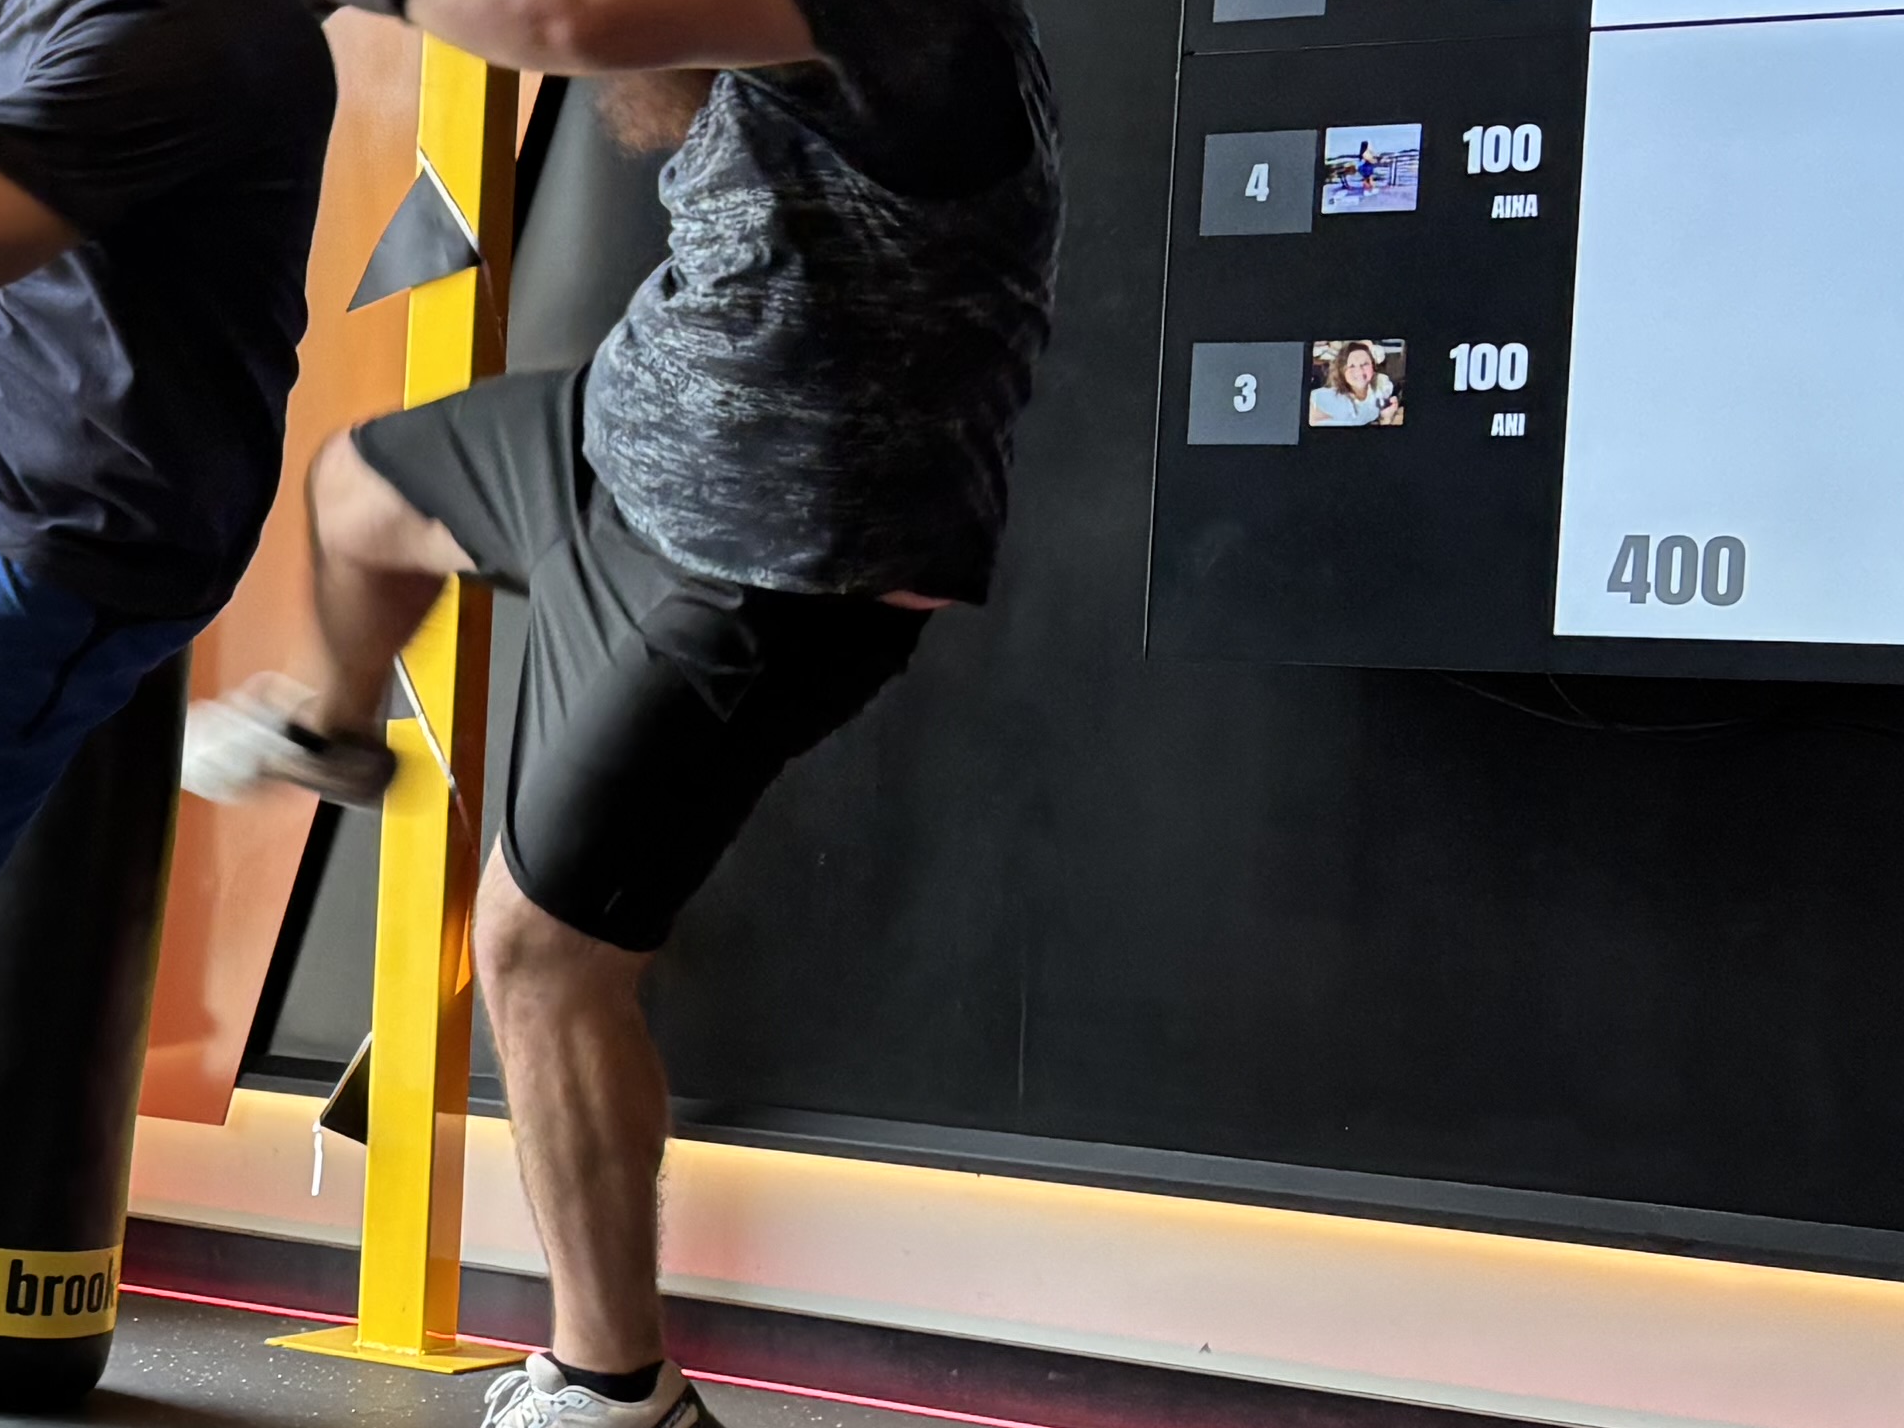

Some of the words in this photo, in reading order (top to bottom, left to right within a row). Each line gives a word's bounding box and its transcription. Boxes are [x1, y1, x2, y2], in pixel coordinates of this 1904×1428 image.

[1462, 123, 1542, 175] 100
[1245, 163, 1270, 202] 4
[1449, 342, 1529, 392] 100
[1233, 373, 1257, 412] 3
[1490, 412, 1526, 437] ANI
[1606, 534, 1746, 607] 400
